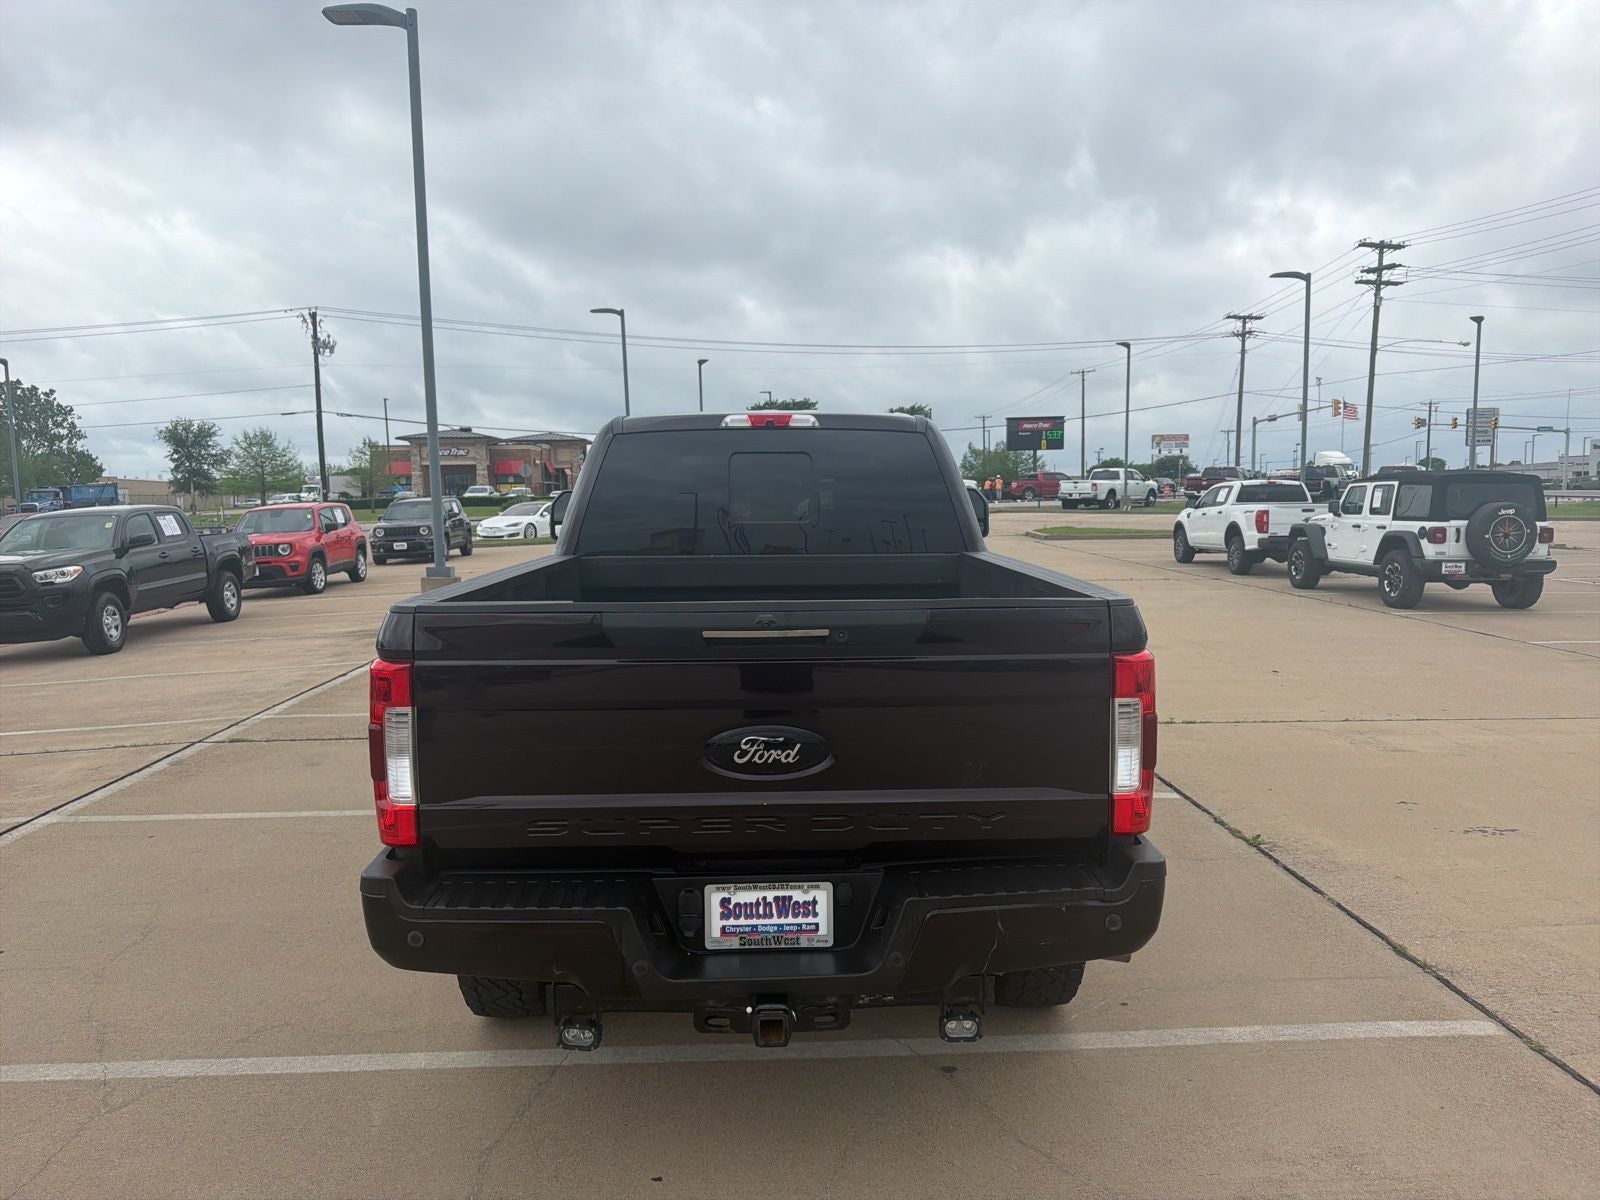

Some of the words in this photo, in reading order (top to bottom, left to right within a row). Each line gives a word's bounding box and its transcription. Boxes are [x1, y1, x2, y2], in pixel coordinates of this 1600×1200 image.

[733, 736, 801, 764] Ford
[526, 815, 787, 837] SUPER
[811, 811, 1007, 832] DUTY
[719, 895, 820, 921] SouthWest
[725, 925, 752, 933] Chrysler
[783, 924, 797, 932] Jeep
[739, 935, 801, 947] SouthWest
